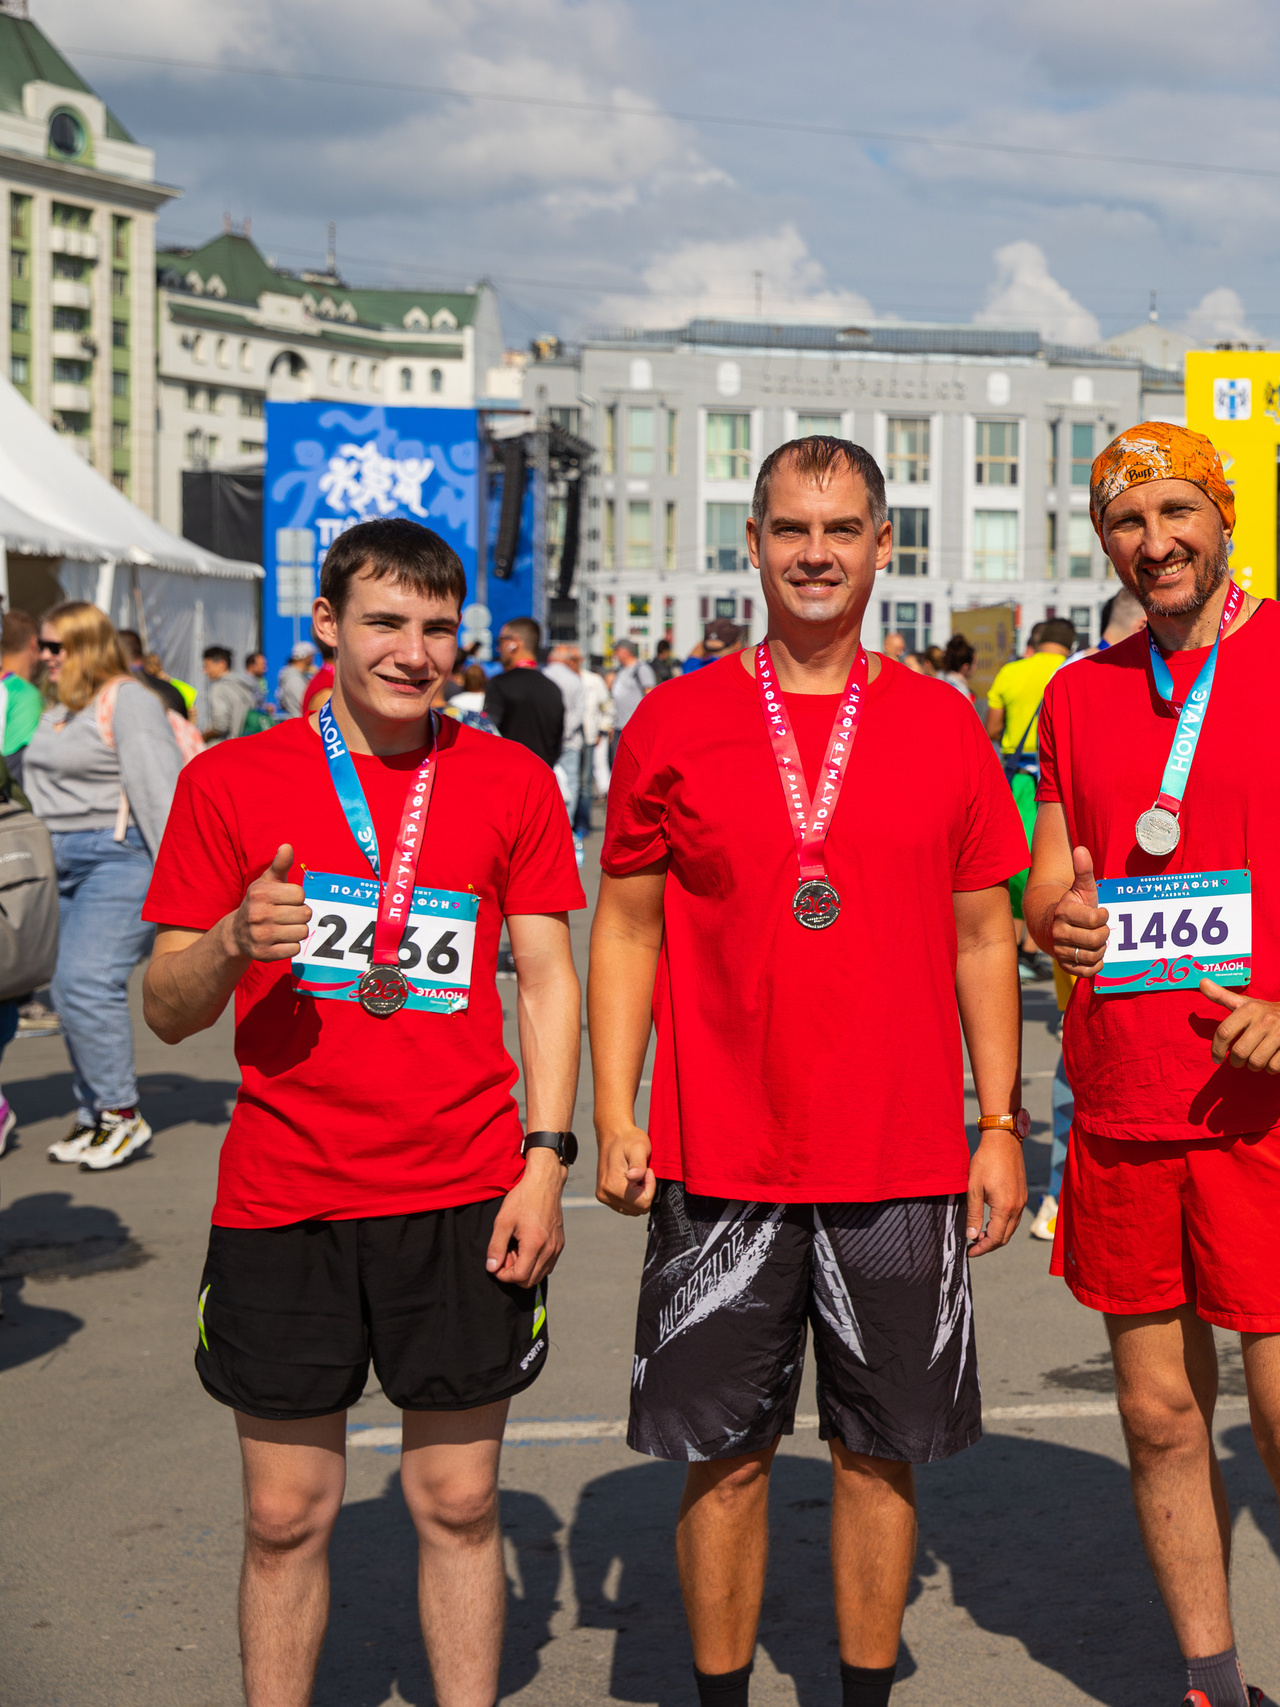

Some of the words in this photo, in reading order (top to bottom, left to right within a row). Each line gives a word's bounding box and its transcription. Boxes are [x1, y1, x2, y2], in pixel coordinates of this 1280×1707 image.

[1169, 690, 1208, 771] ЭТАЛОН
[812, 694, 860, 833] ПОЛУМАРАФОН
[388, 769, 430, 919] ПОЛУМАРАФОН
[1117, 879, 1219, 894] ПОЛУМАРАФОН
[311, 914, 460, 974] 2466
[1118, 906, 1229, 951] 1466
[1145, 954, 1194, 986] 26
[1202, 961, 1244, 972] ЭТАЛОН
[416, 987, 464, 1001] ЭТАЛОН
[520, 1339, 545, 1371] SPORTS
